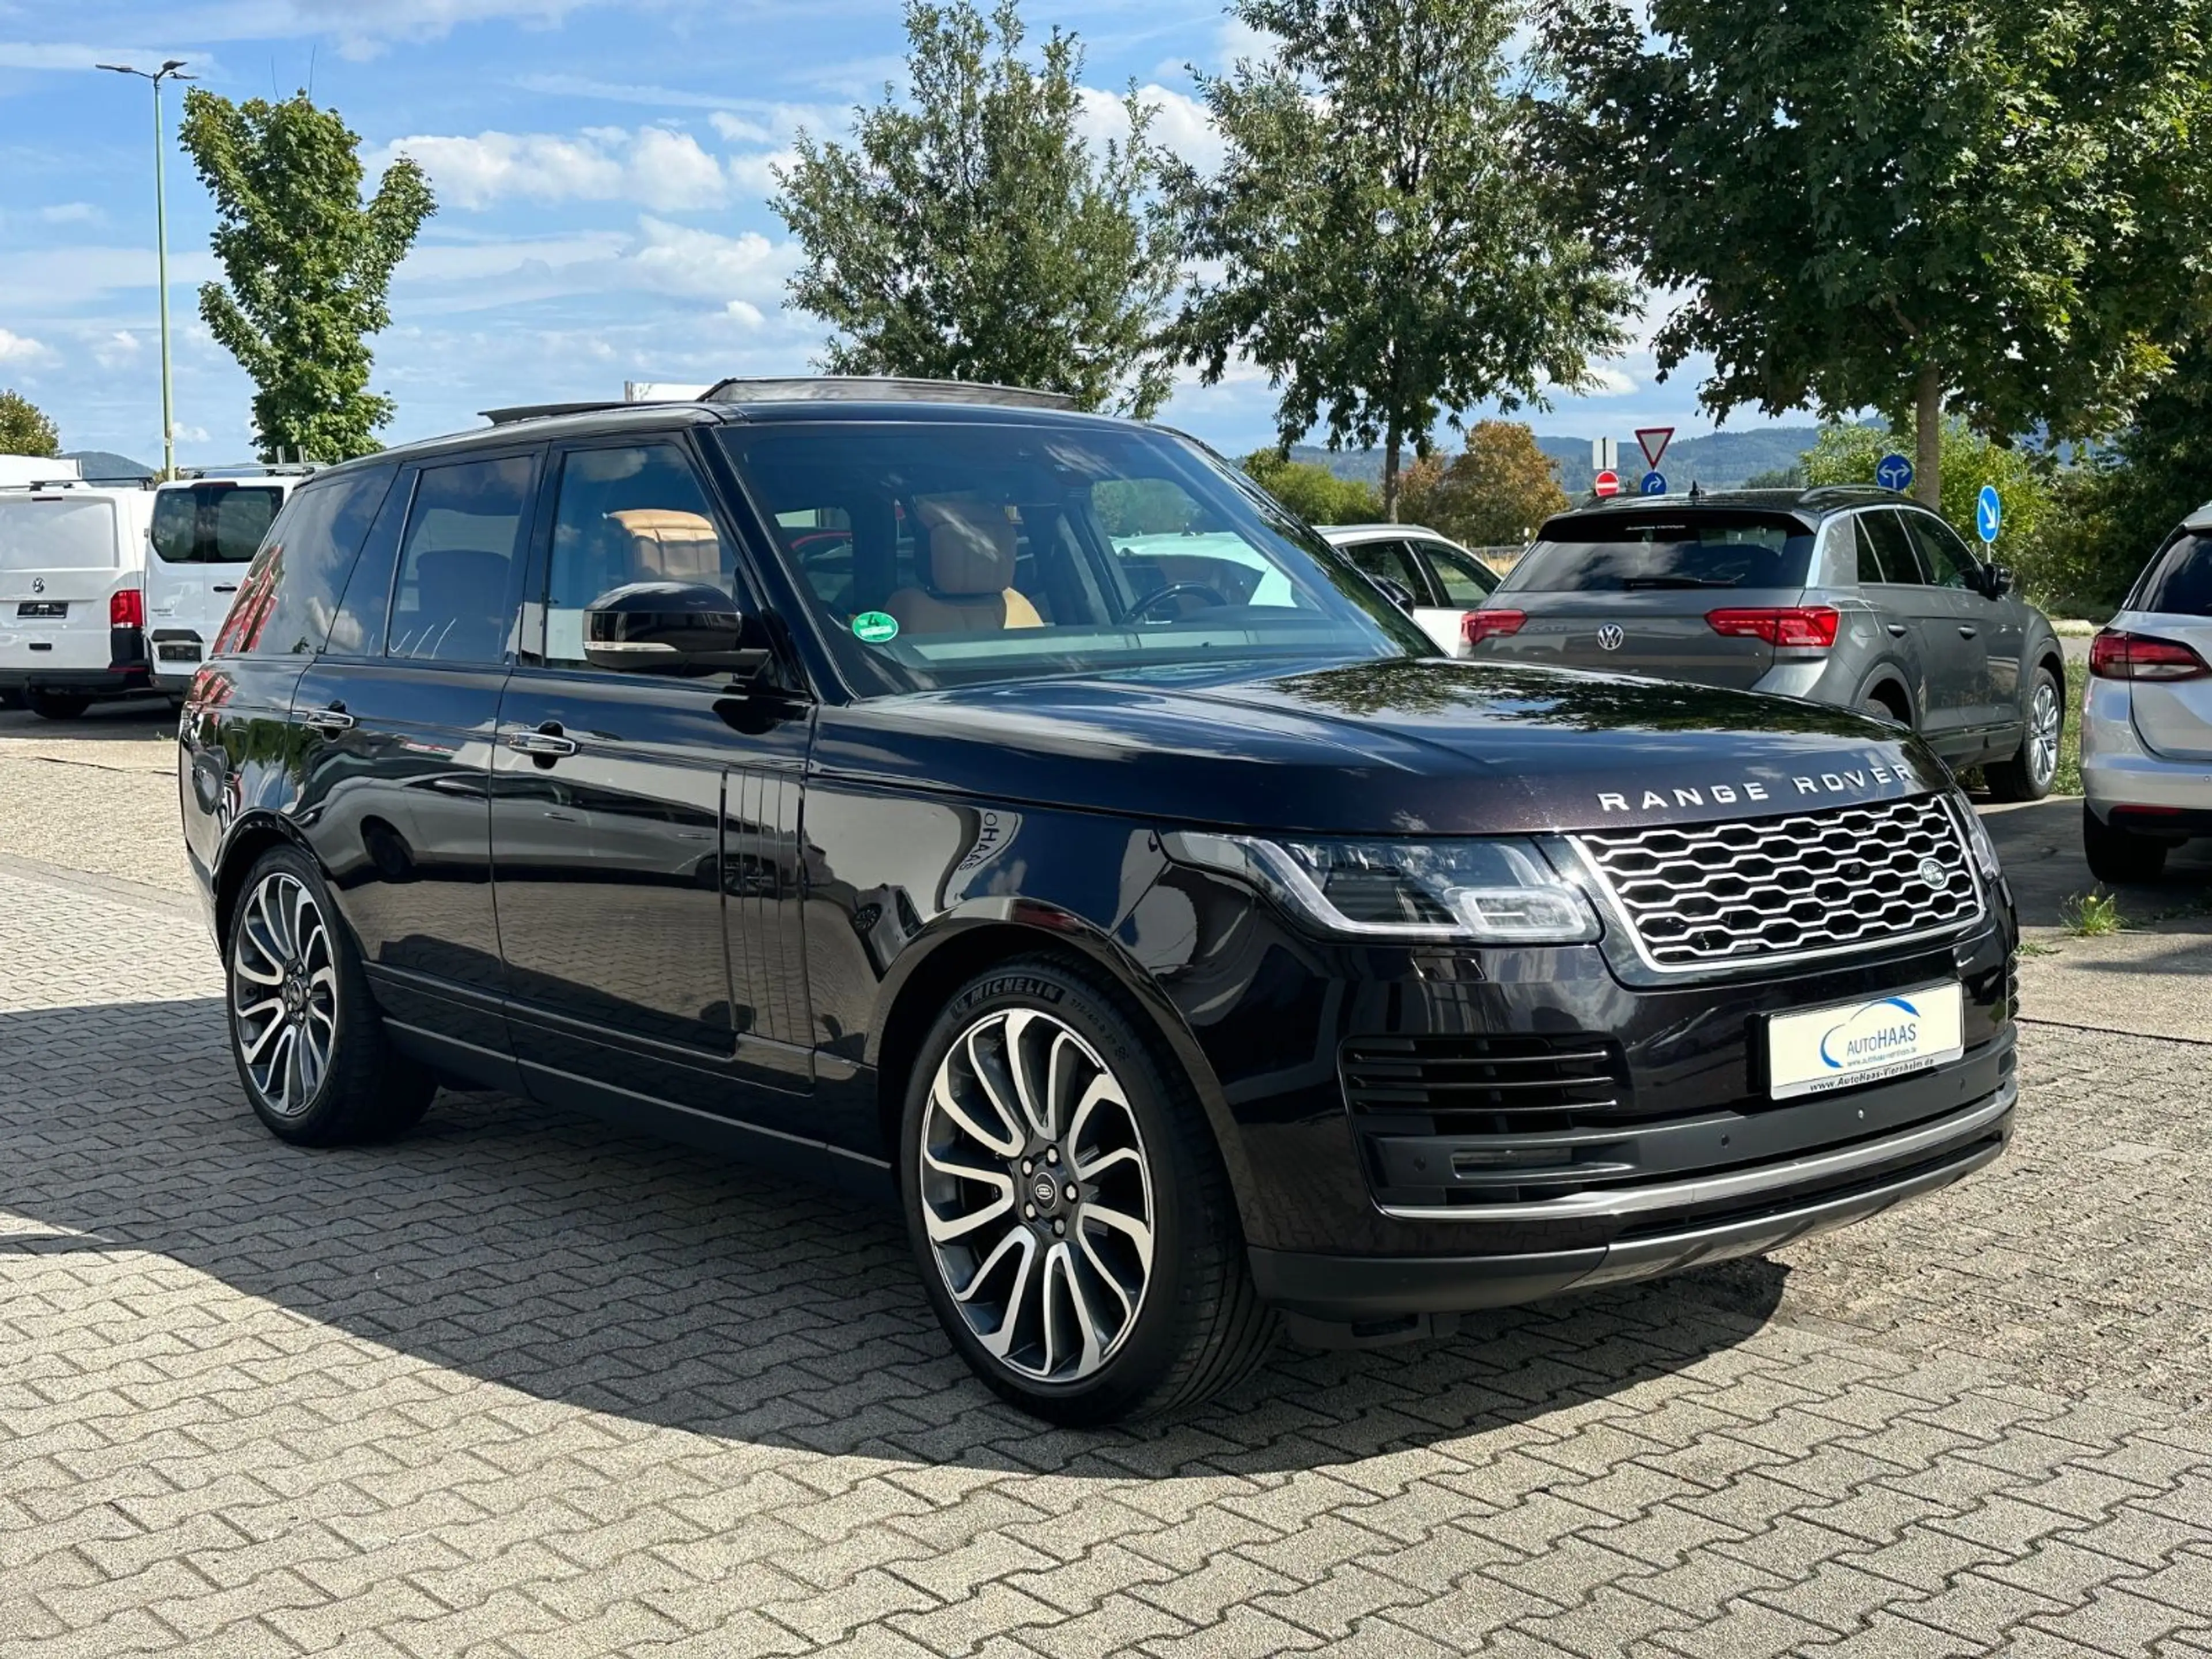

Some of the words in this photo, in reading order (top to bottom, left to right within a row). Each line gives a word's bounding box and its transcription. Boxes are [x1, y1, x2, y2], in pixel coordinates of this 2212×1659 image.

[868, 614, 880, 627] 4
[1597, 782, 1769, 811] RANGE
[1791, 764, 1914, 794] ROVER
[970, 978, 1060, 1004] MICHELIN
